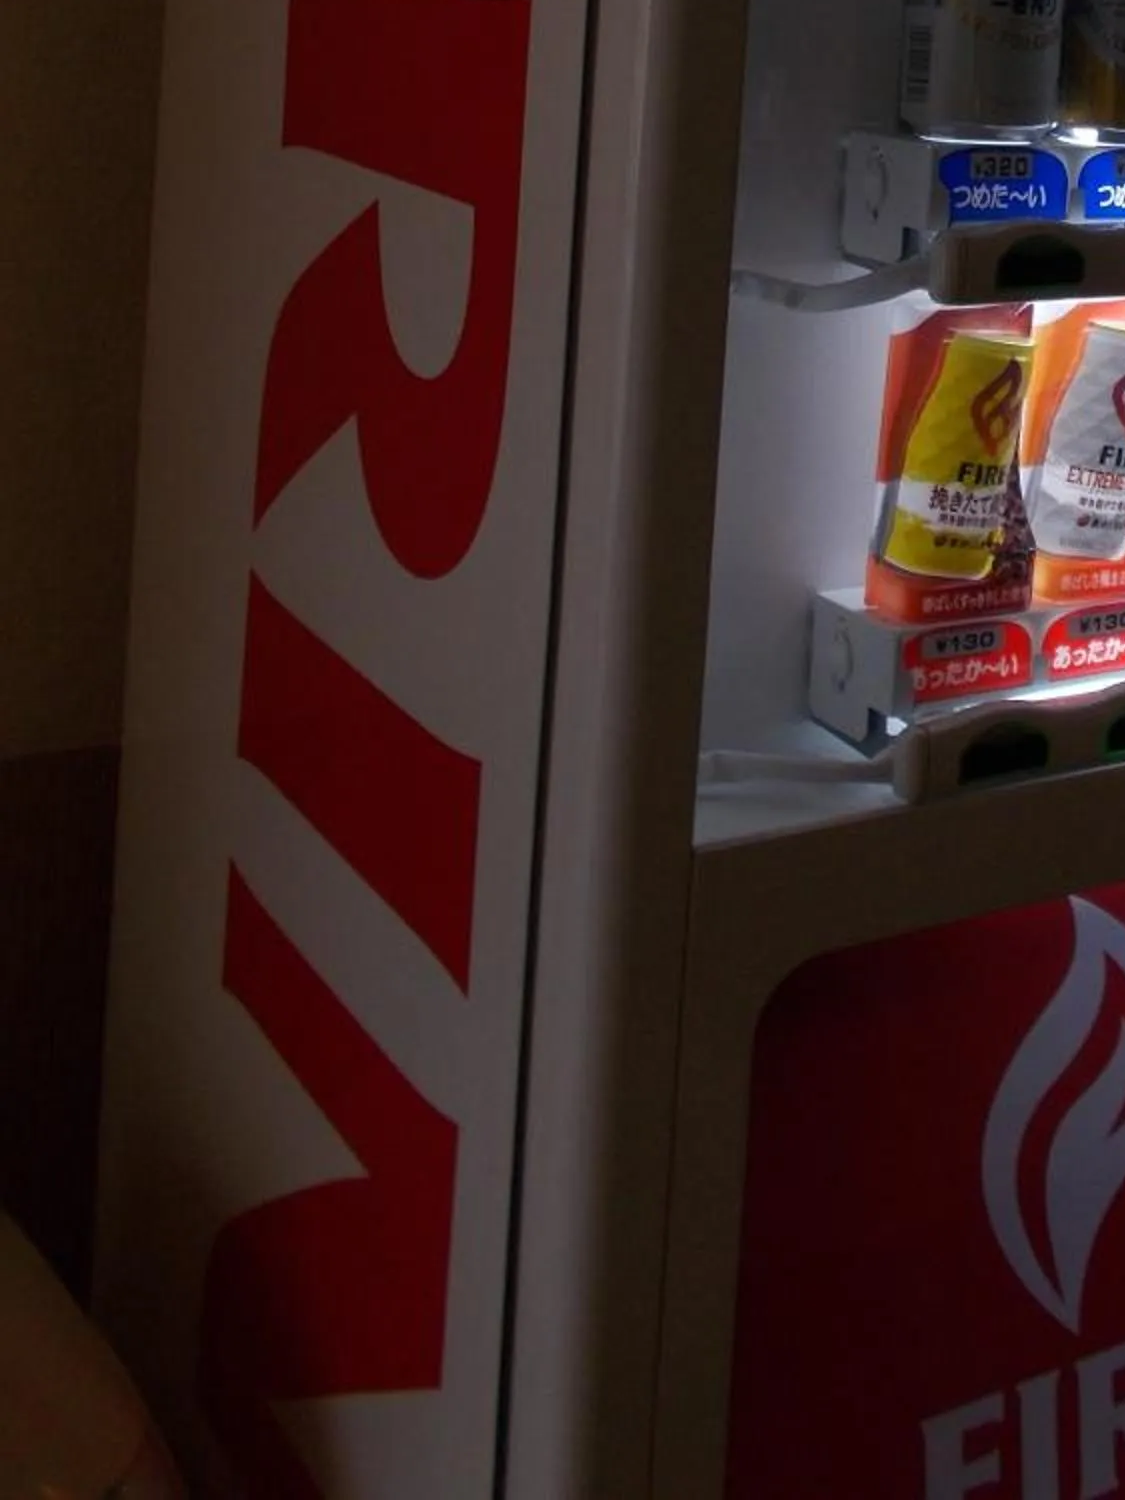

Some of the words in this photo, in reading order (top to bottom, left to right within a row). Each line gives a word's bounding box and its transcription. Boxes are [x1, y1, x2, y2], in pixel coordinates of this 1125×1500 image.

[953, 184, 1047, 209] つめた～い
[935, 630, 995, 653] ¥130
